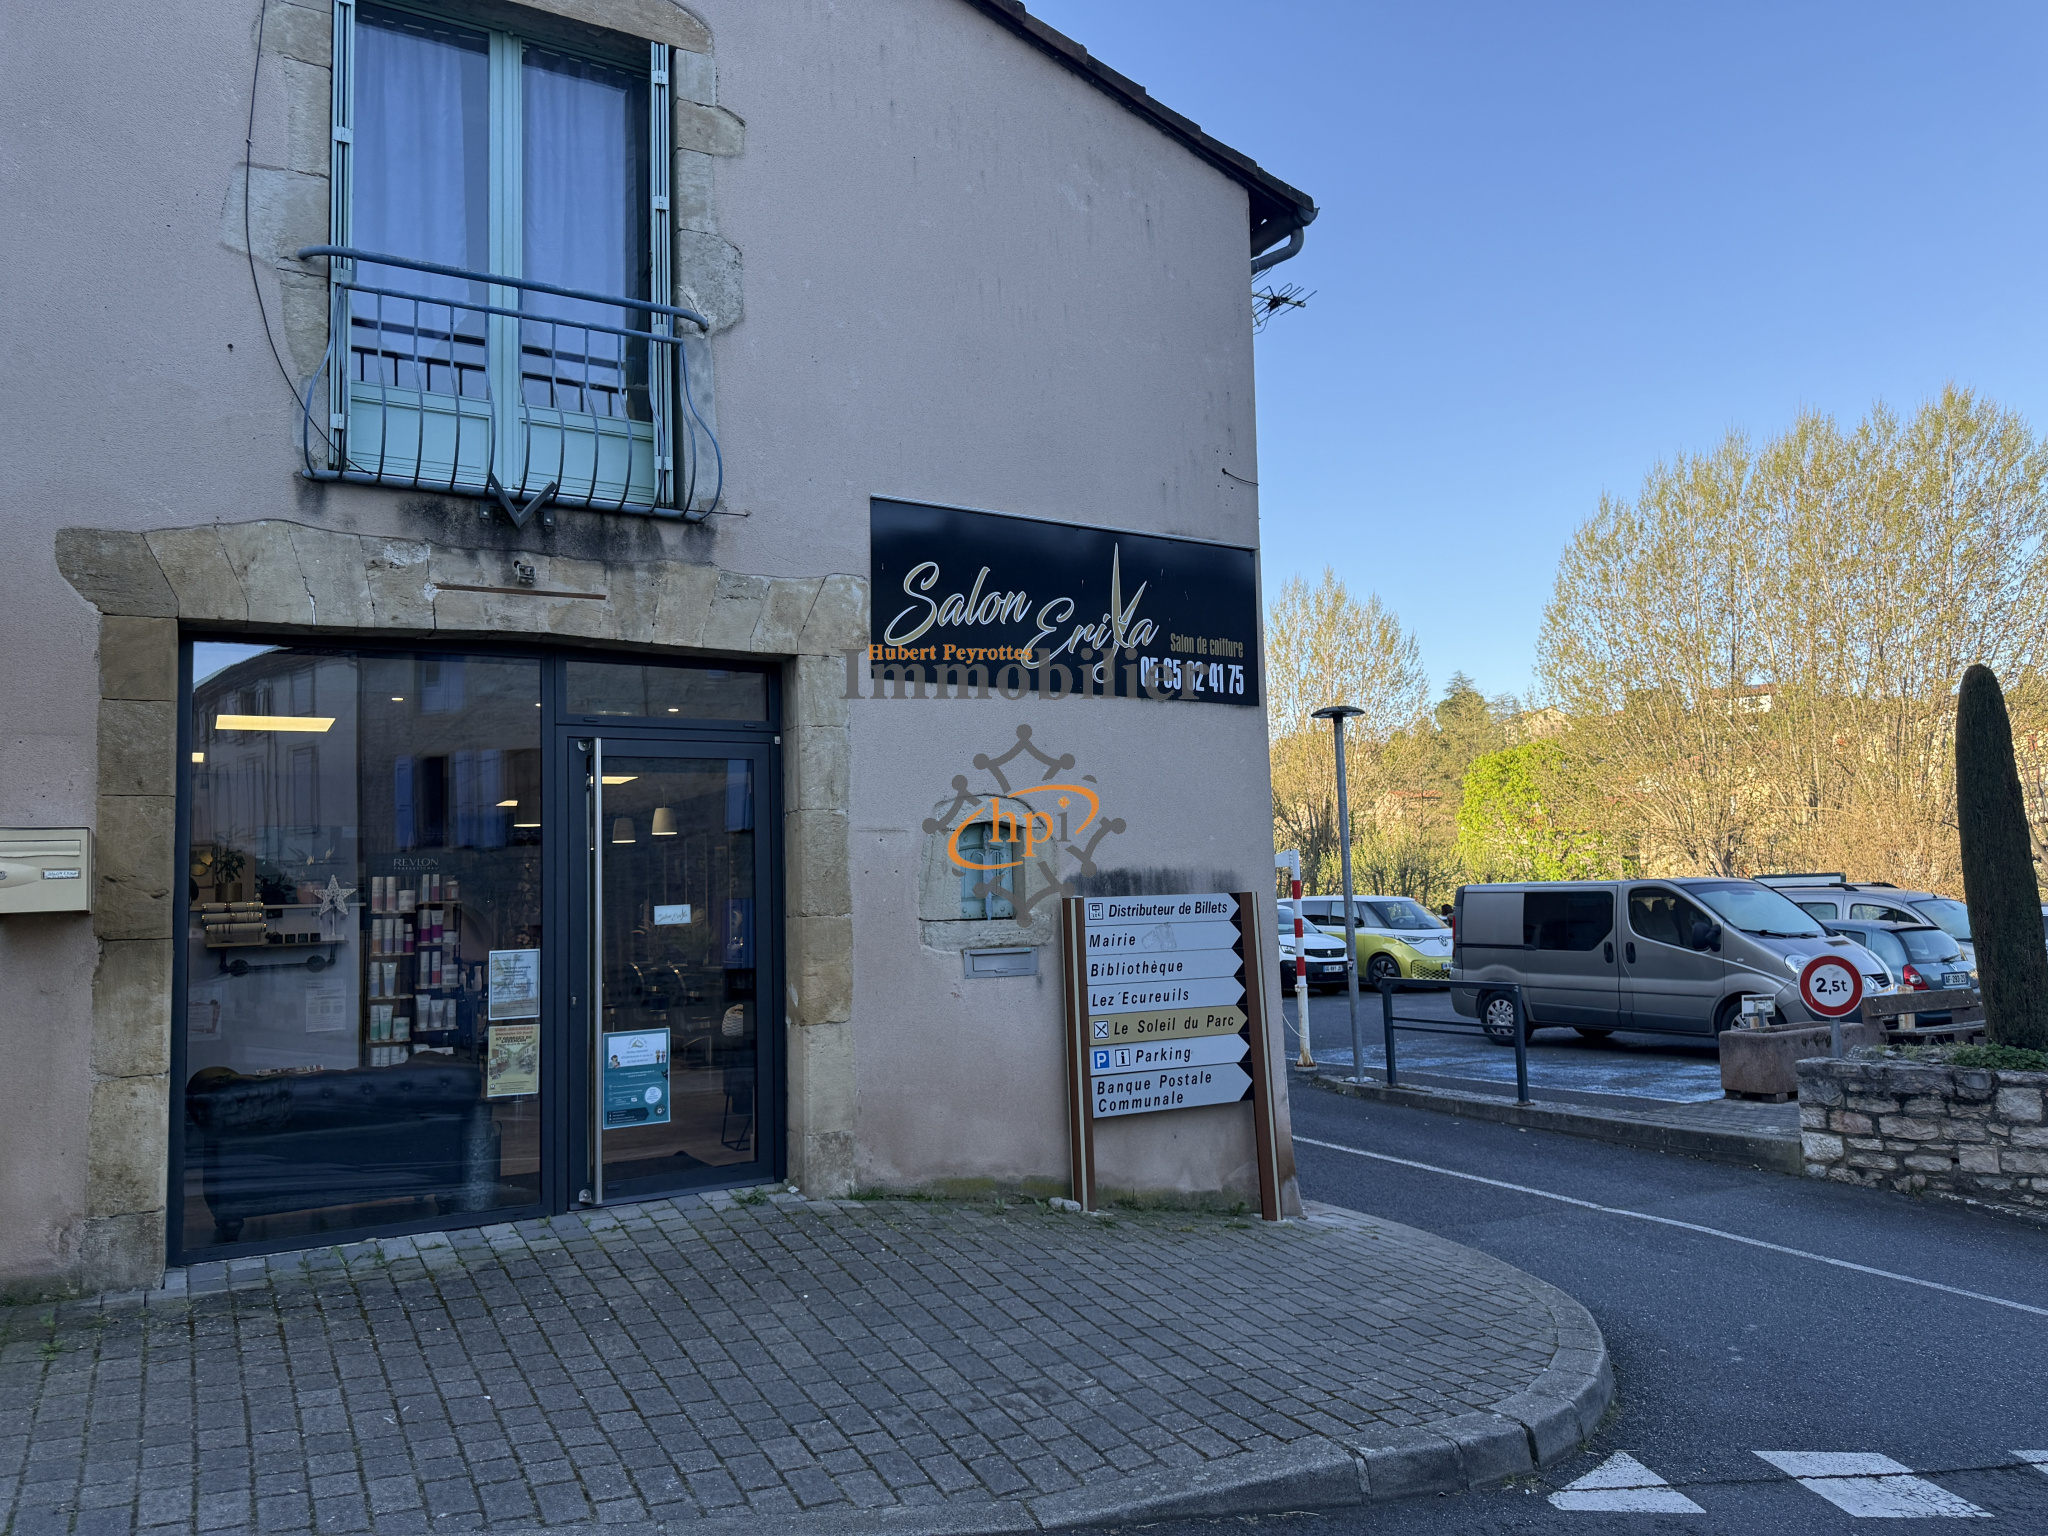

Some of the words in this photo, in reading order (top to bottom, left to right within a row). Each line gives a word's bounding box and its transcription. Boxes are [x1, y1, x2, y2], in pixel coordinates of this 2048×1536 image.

[884, 561, 1032, 647] Salon
[1021, 542, 1159, 684] Erika
[1170, 632, 1194, 654] Salon
[1196, 636, 1207, 654] de
[1210, 638, 1244, 658] coiffure
[1140, 656, 1158, 688] 05
[1209, 662, 1224, 694] 41
[1228, 664, 1244, 694] 75
[393, 858, 439, 866] REVLON
[1108, 904, 1174, 917] Distributeur
[1178, 902, 1191, 915] de
[1194, 901, 1228, 914] Billets
[1089, 933, 1136, 948] Mairie
[1091, 960, 1183, 977] Bibliothèque
[1815, 978, 1848, 995] 2,5t
[1114, 1021, 1128, 1035] Le
[1138, 1018, 1175, 1033] Soleil
[1184, 1016, 1198, 1030] du
[1206, 1014, 1234, 1028] Parc
[1096, 1052, 1107, 1067] P
[1136, 1048, 1191, 1064] Parking
[1097, 1078, 1151, 1095] Banque
[1159, 1071, 1212, 1088] Postale
[1098, 1092, 1183, 1113] Communale
